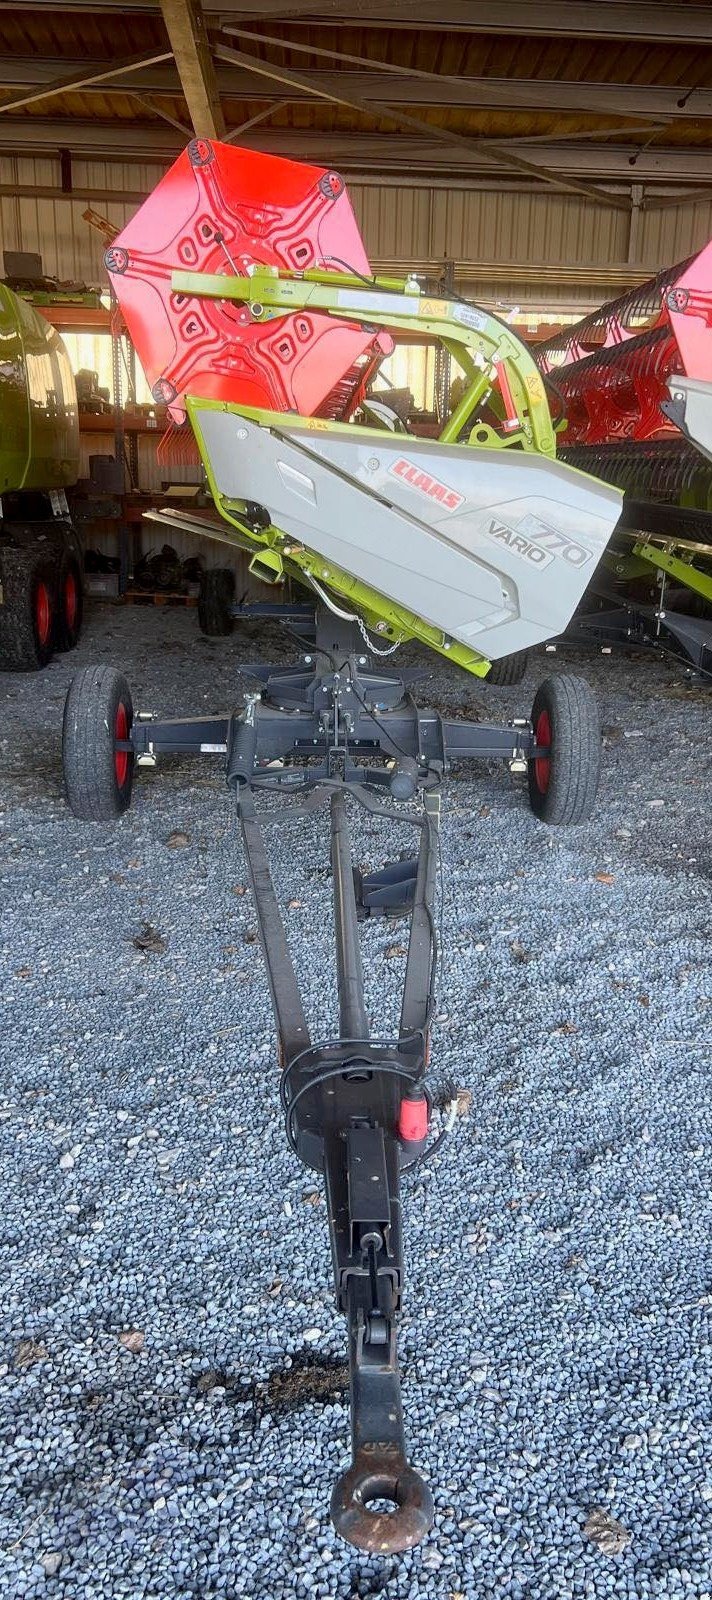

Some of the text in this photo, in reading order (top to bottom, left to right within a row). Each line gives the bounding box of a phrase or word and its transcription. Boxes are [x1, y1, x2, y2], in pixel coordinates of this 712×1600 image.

[392, 460, 460, 509] CLAAS
[488, 520, 546, 563] VARIO
[530, 523, 588, 565] 770
